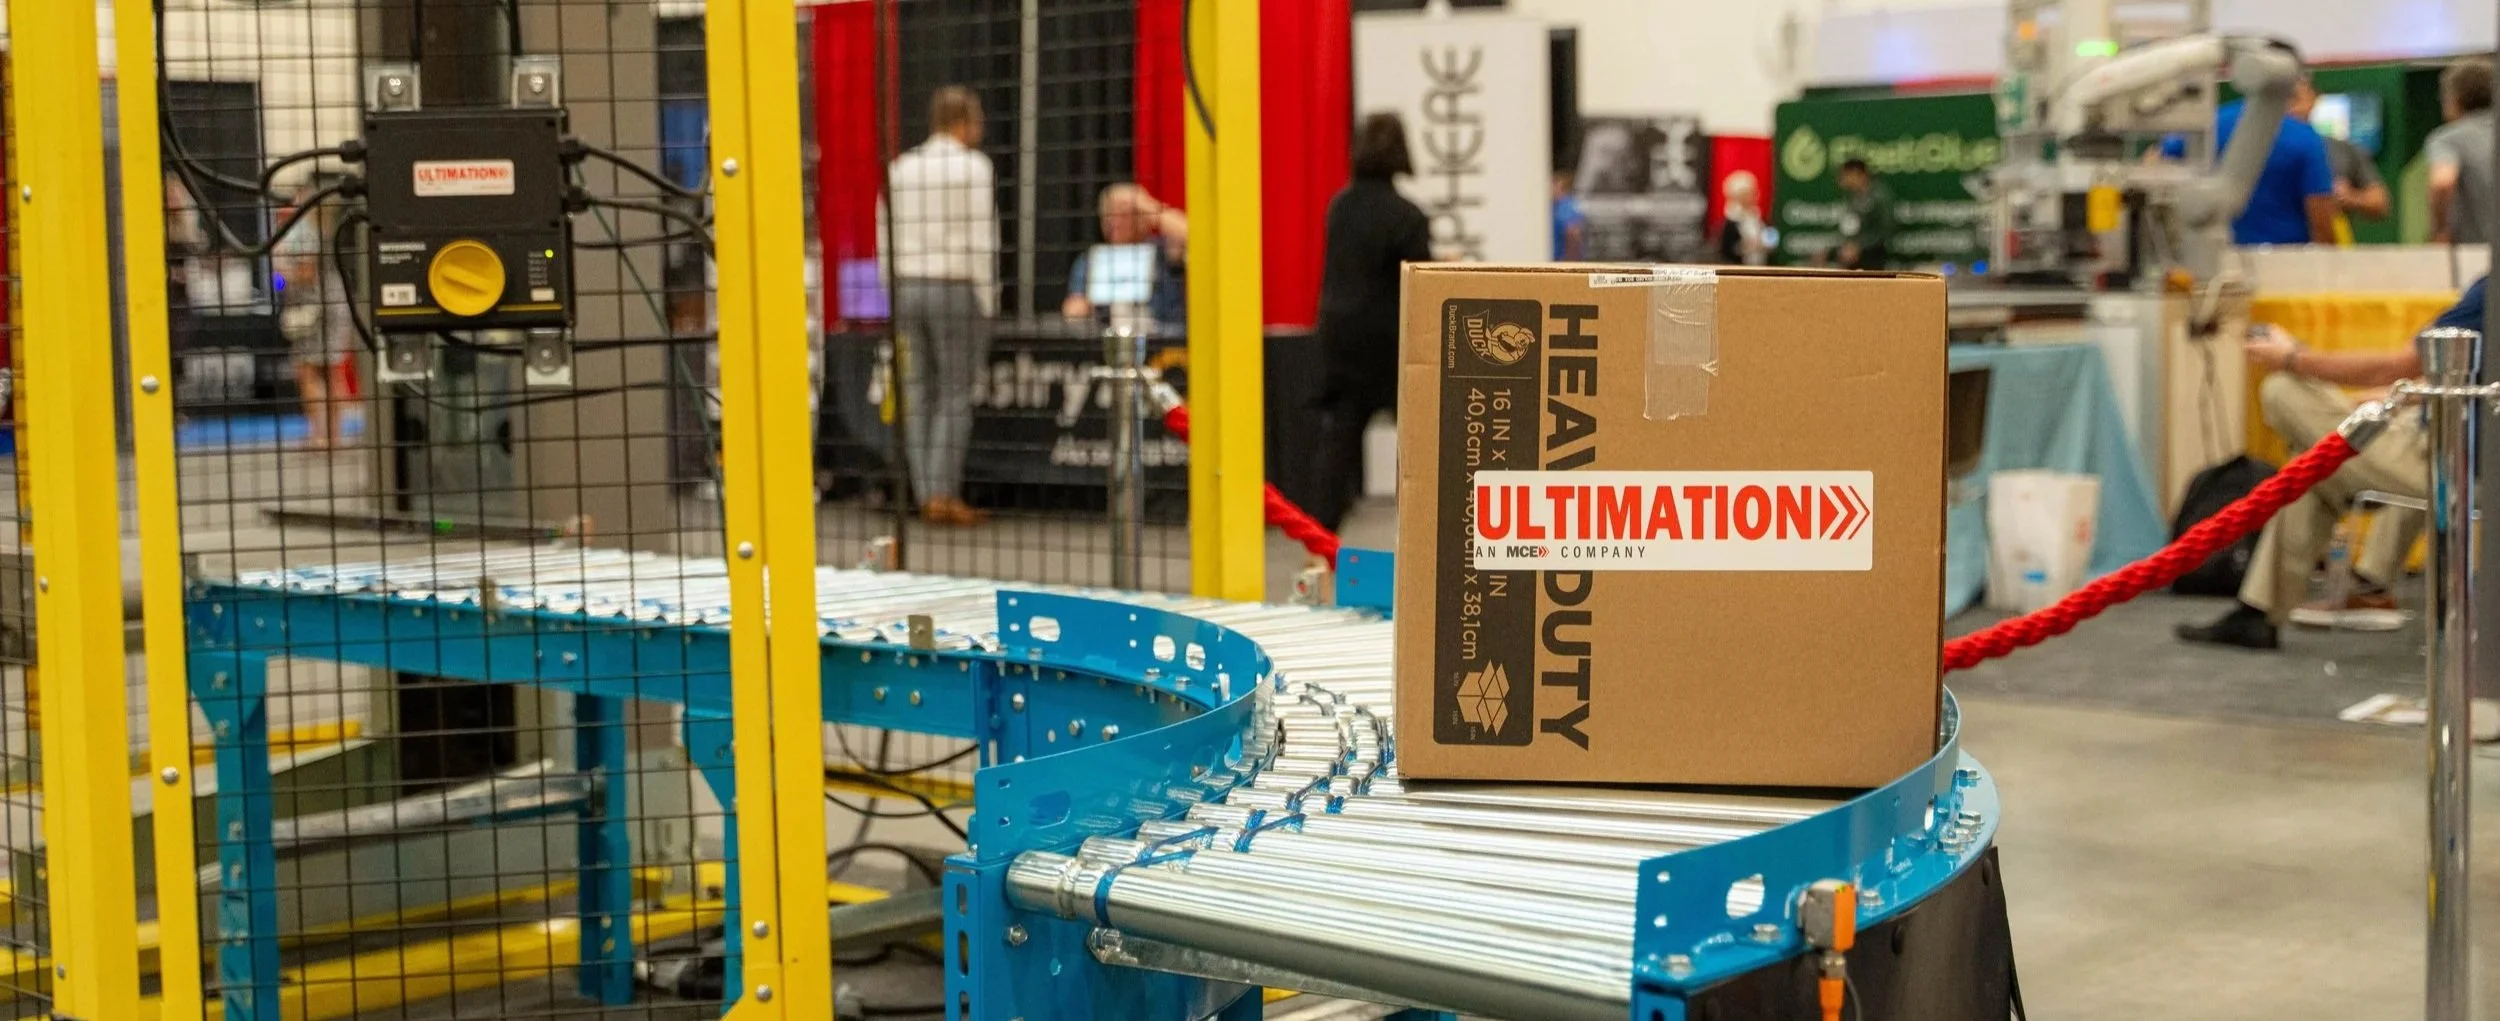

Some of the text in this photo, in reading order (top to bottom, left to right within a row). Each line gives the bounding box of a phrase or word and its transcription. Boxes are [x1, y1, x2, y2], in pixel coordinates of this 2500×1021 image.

[419, 167, 498, 181] ULTIMATION
[1448, 304, 1458, 370] DuckBrand.com
[1467, 318, 1492, 357] DUCK
[1464, 387, 1486, 467] 40,6cm
[1477, 485, 1812, 541] ULTIMATION
[1489, 388, 1511, 597] 16 IN x IN
[1464, 574, 1478, 585] x
[1475, 545, 1646, 559] AN MCE COMPANY
[1459, 591, 1482, 660] 38,1cm
[1540, 570, 1594, 752] DUTY
